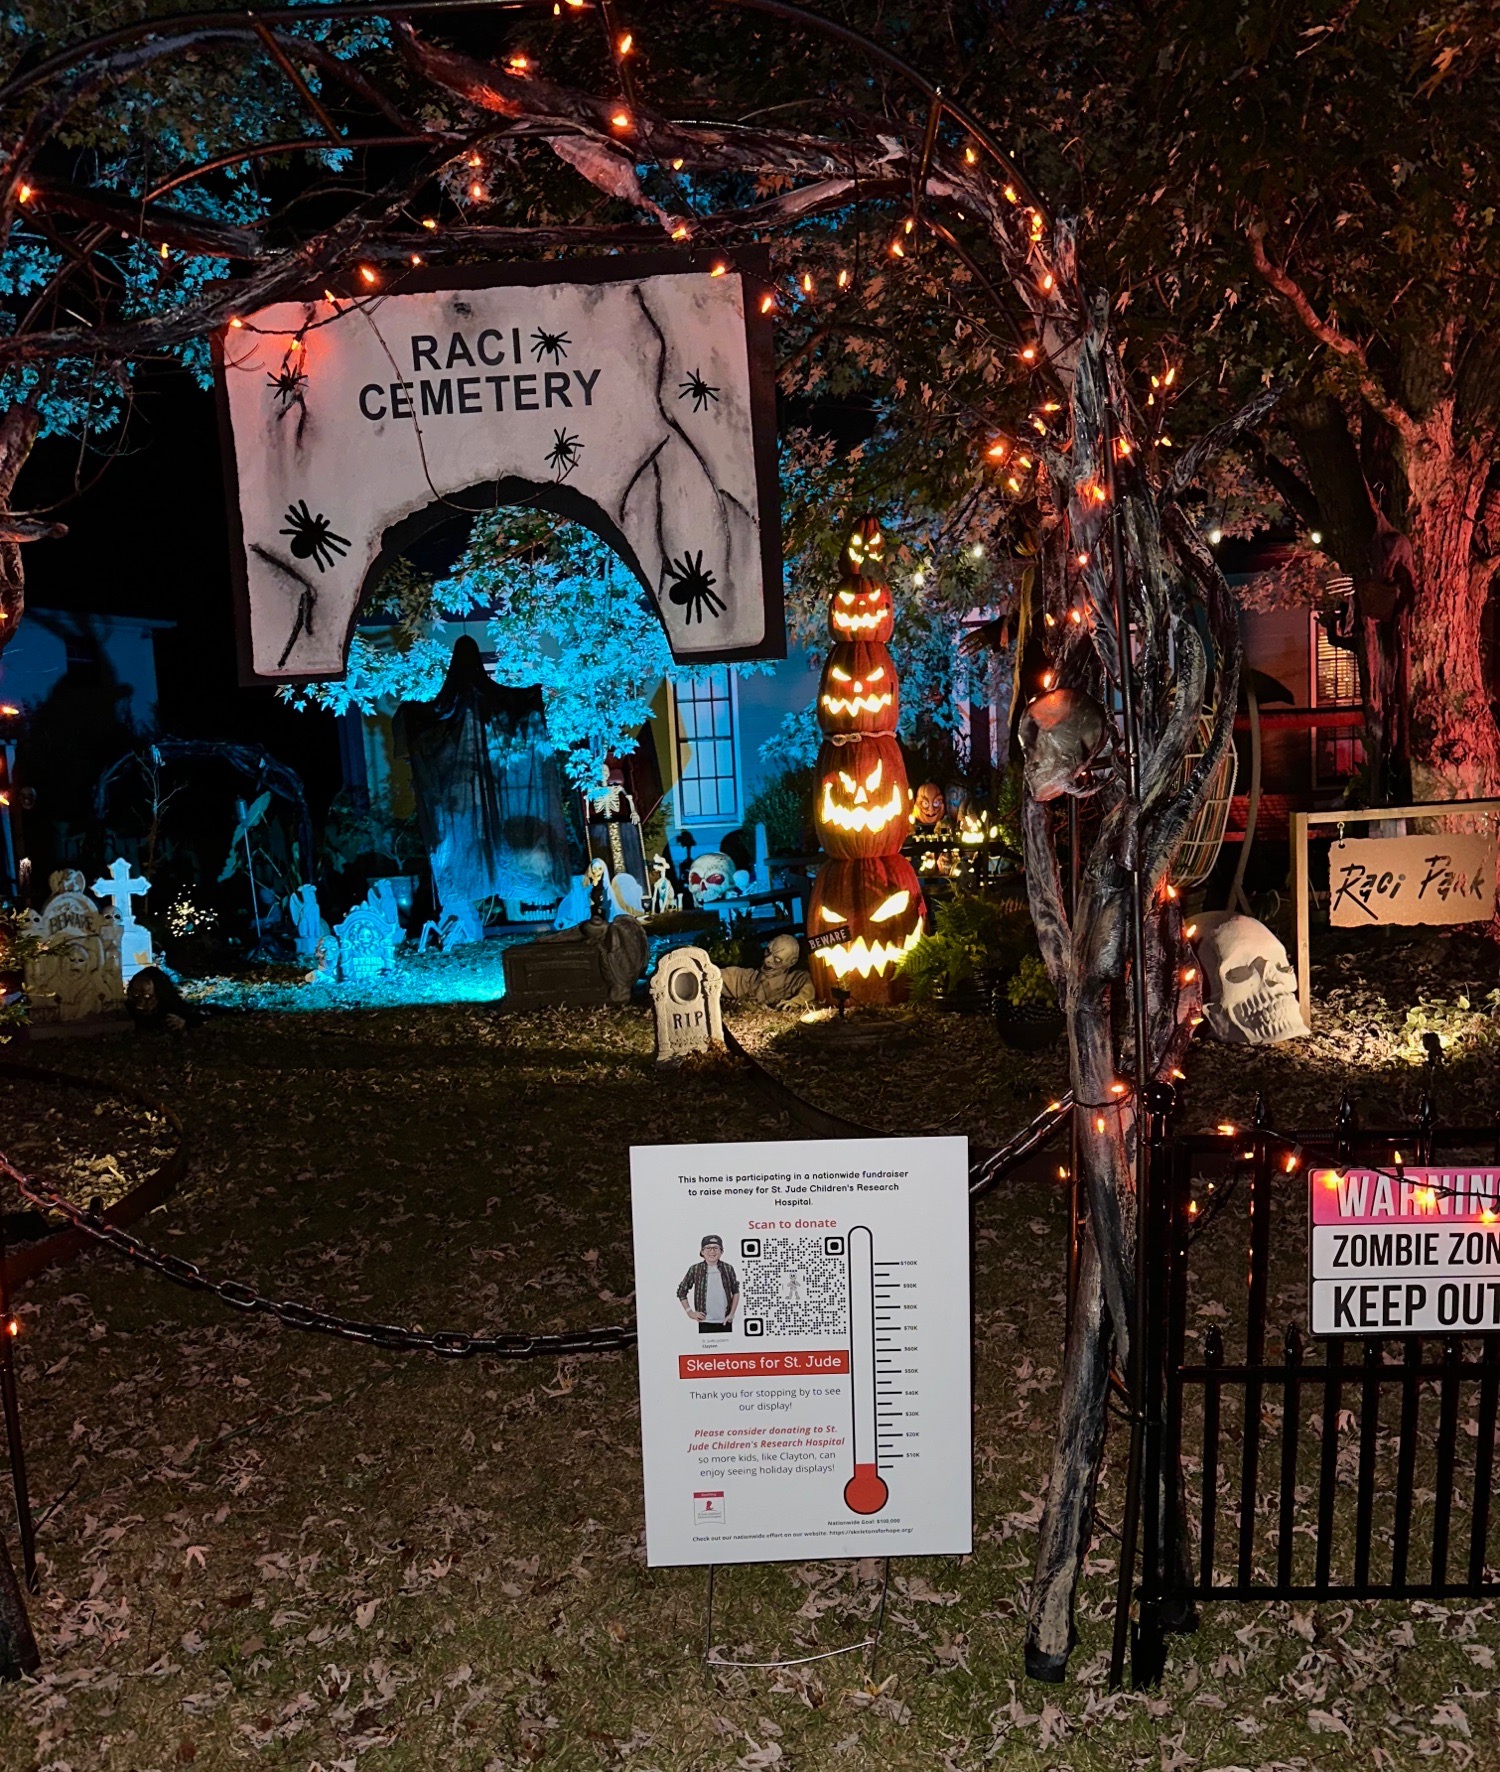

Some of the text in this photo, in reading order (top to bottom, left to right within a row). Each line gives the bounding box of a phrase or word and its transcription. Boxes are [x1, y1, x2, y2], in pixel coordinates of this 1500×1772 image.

[411, 328, 522, 372] RACI
[358, 368, 602, 421] CEMETERY
[1333, 855, 1485, 920] Raci Park
[808, 929, 847, 950] BEWARE
[672, 1010, 703, 1029] RIP
[699, 1175, 723, 1183] home
[736, 1173, 791, 1183] participating
[812, 1171, 860, 1179] nationwide
[862, 1170, 909, 1178] fundraiser
[724, 1188, 754, 1196] money
[809, 1184, 854, 1192] Children's
[857, 1183, 899, 1191] Research
[1336, 1174, 1500, 1217] WARNIN
[774, 1198, 813, 1208] Hospital.
[748, 1219, 837, 1230] Scan to donate
[1332, 1232, 1500, 1268] ZOMBIE ZON
[1334, 1283, 1500, 1328] KEEP OUT
[686, 1356, 842, 1372] Skeletons for St. Jude
[690, 1391, 718, 1400] Thank
[720, 1392, 738, 1400] you
[756, 1389, 796, 1398] stopping
[799, 1388, 811, 1397] by
[757, 1402, 792, 1411] display!
[695, 1429, 725, 1438] Please
[727, 1428, 766, 1436] consider
[769, 1426, 811, 1435] donating
[687, 1437, 845, 1452] Jude Children's Research Hospital
[738, 1454, 759, 1462] kids,
[780, 1451, 817, 1462] Clayton,
[700, 1464, 835, 1478] enjoy seeing holiday displays!
